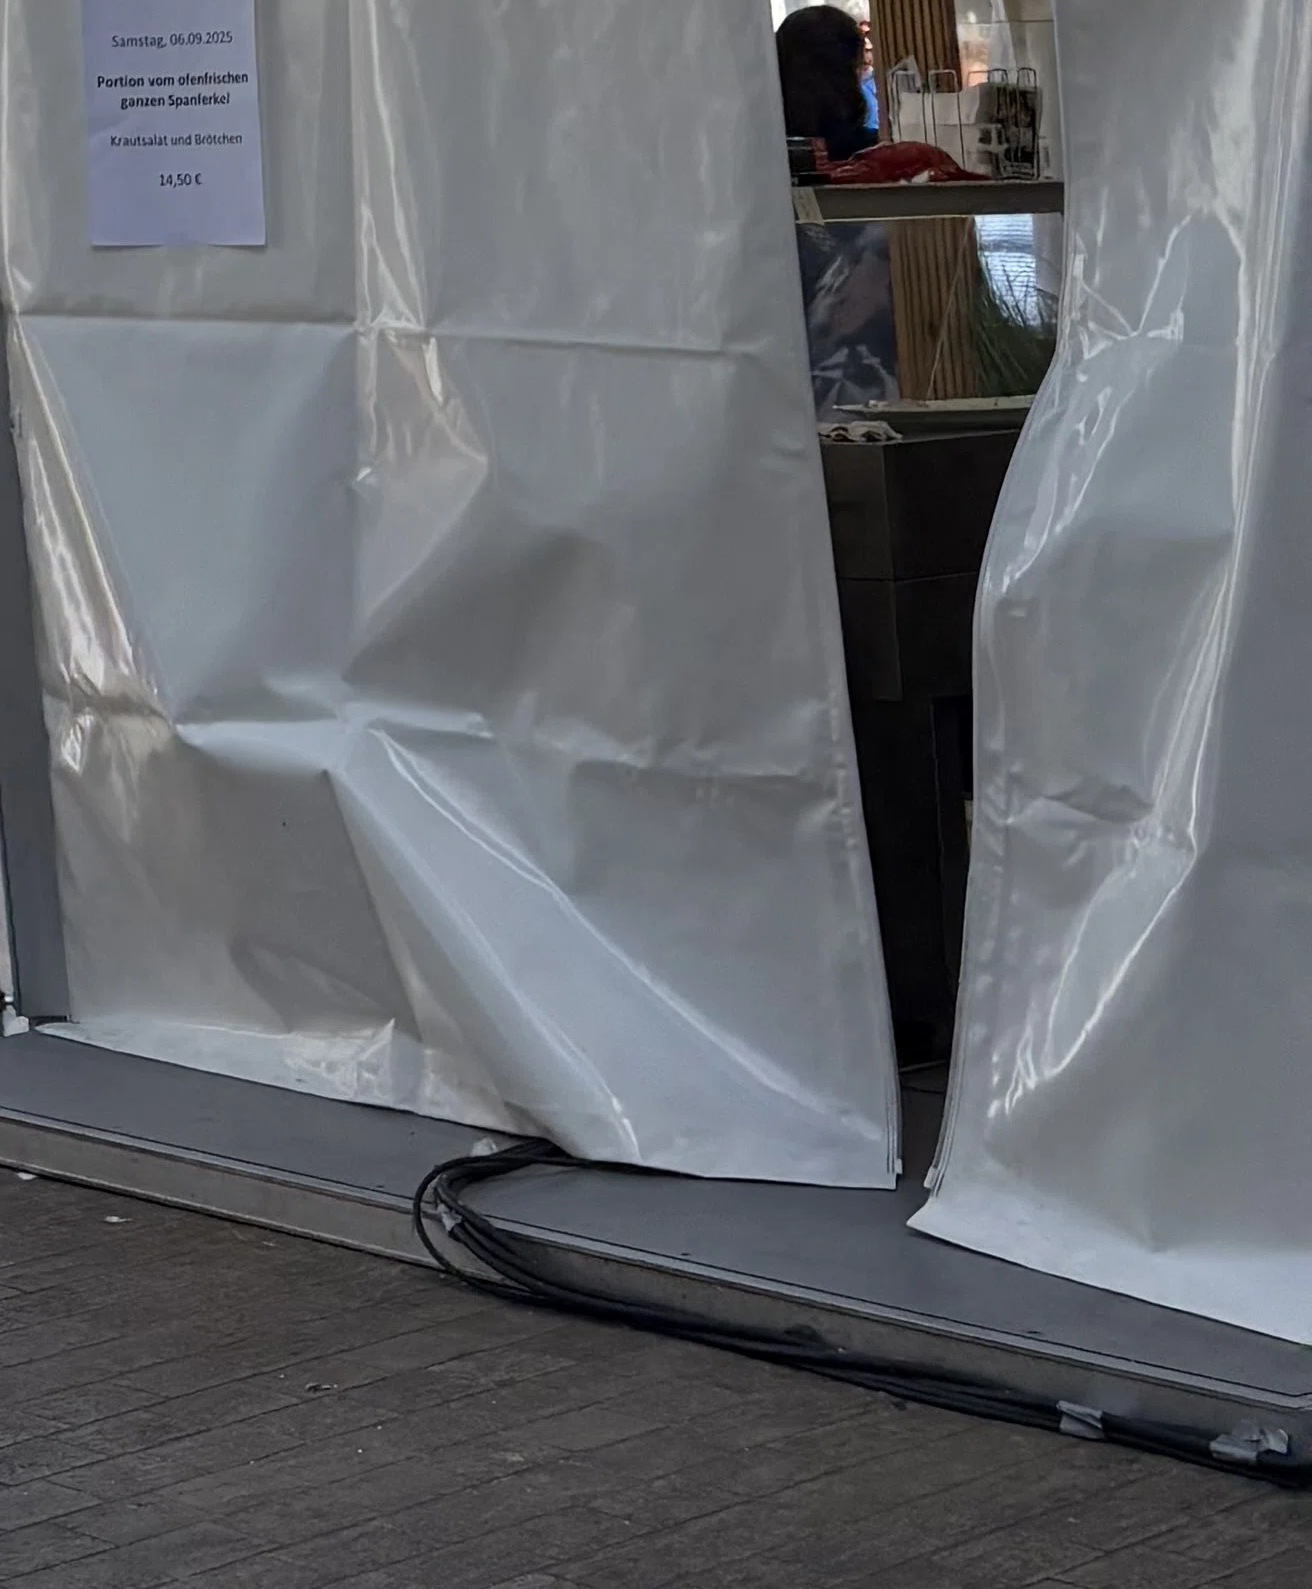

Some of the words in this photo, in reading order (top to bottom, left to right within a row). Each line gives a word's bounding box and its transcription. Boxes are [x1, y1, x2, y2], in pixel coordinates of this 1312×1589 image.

[111, 34, 167, 49] Samstag,
[169, 30, 234, 46] 06.09.2025
[97, 74, 145, 88] Portion
[148, 76, 175, 87] vom
[178, 71, 249, 86] ofenfrischen
[120, 95, 166, 110] ganzen
[168, 92, 231, 109] Spanferkel
[110, 134, 169, 147] Krautsalat
[171, 133, 192, 146] und
[194, 131, 243, 145] Brötchen
[159, 172, 192, 189] 14,50
